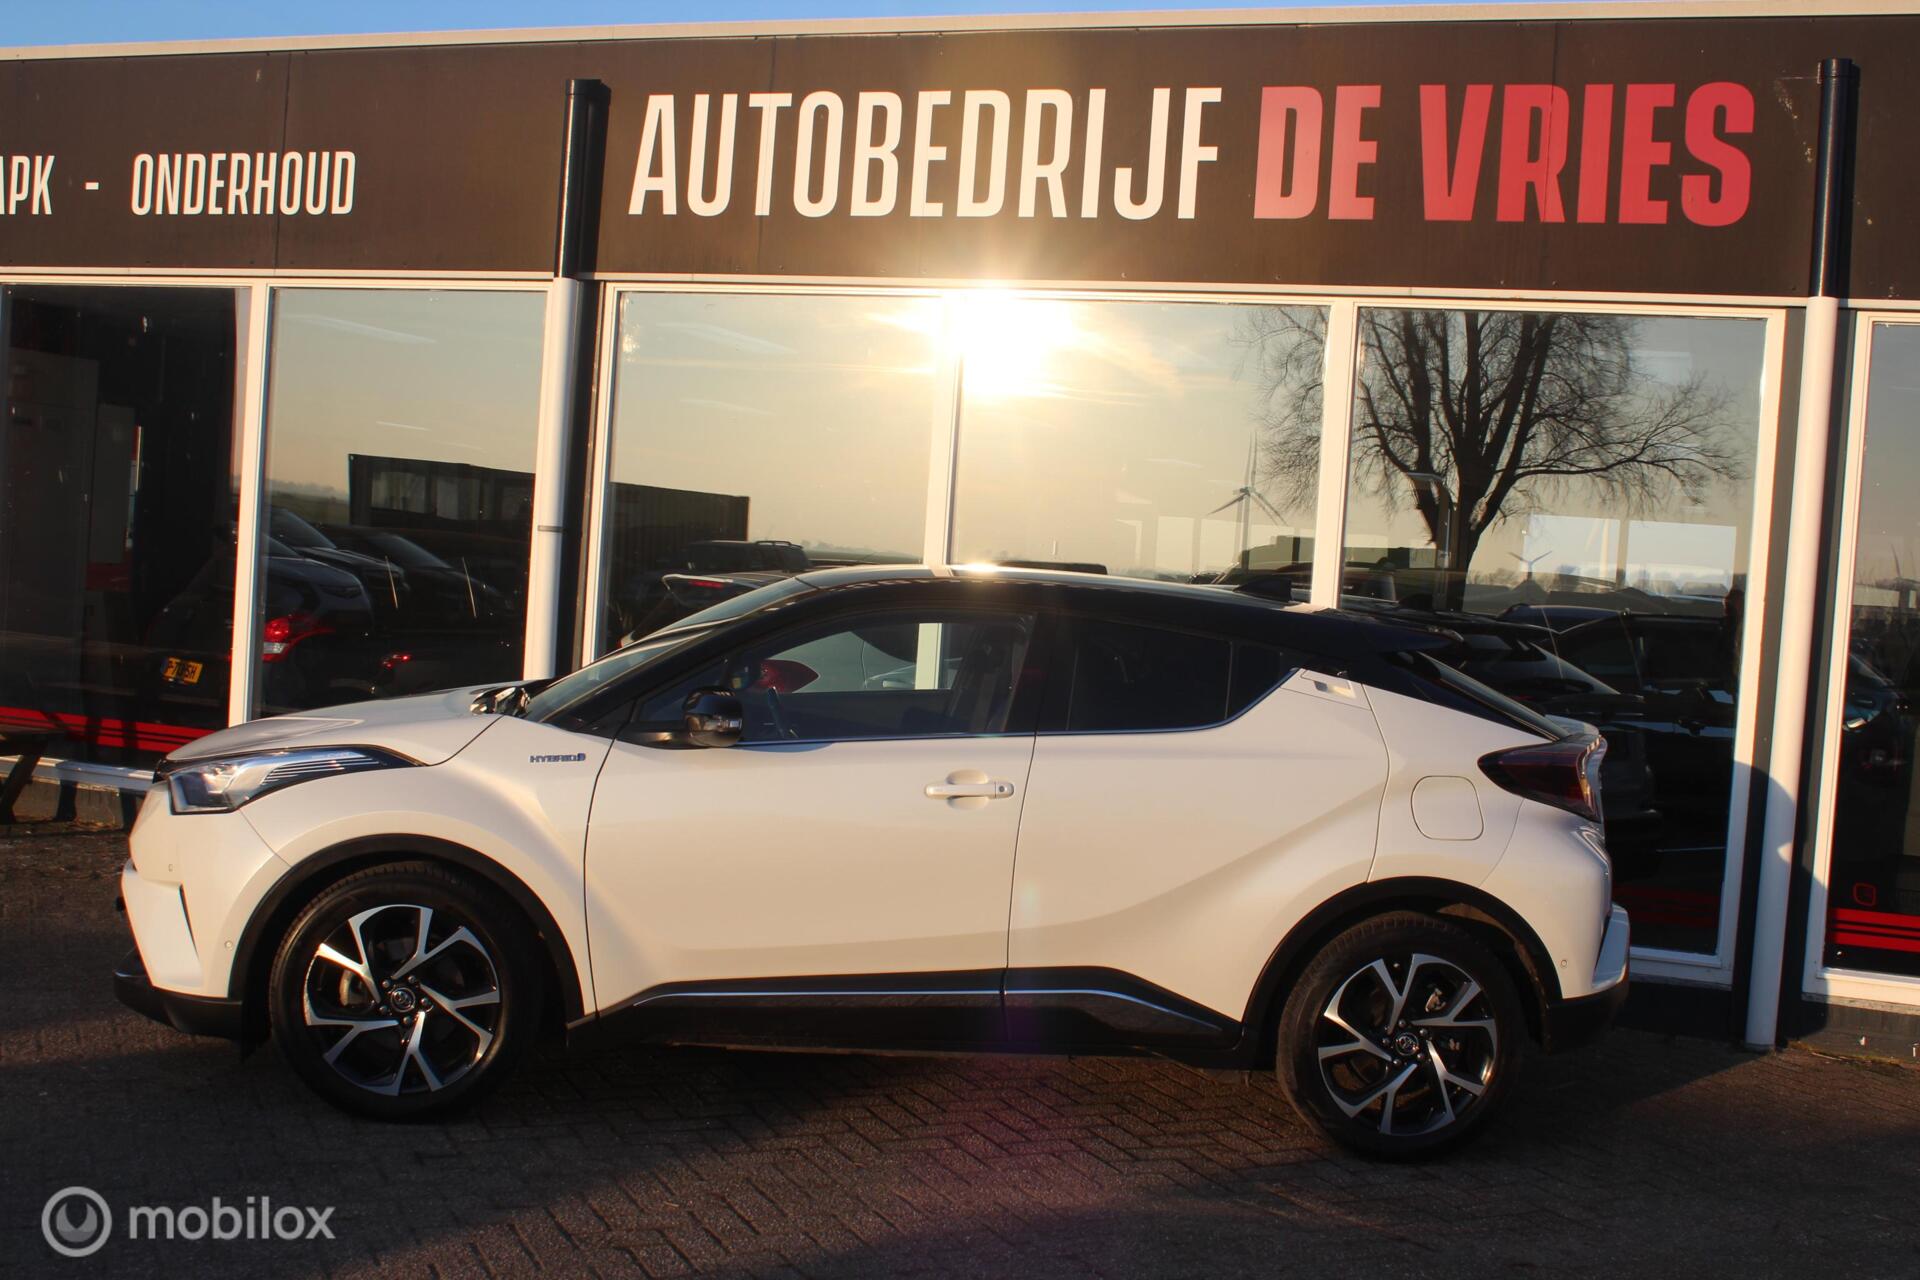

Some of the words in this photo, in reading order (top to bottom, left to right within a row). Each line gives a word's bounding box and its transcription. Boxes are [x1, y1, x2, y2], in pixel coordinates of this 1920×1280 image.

[131, 151, 356, 215] ONDERHOUD
[628, 87, 1222, 220] AUTOBEDRIJF
[1254, 85, 1381, 220] DE
[1419, 82, 1755, 227] VRIES
